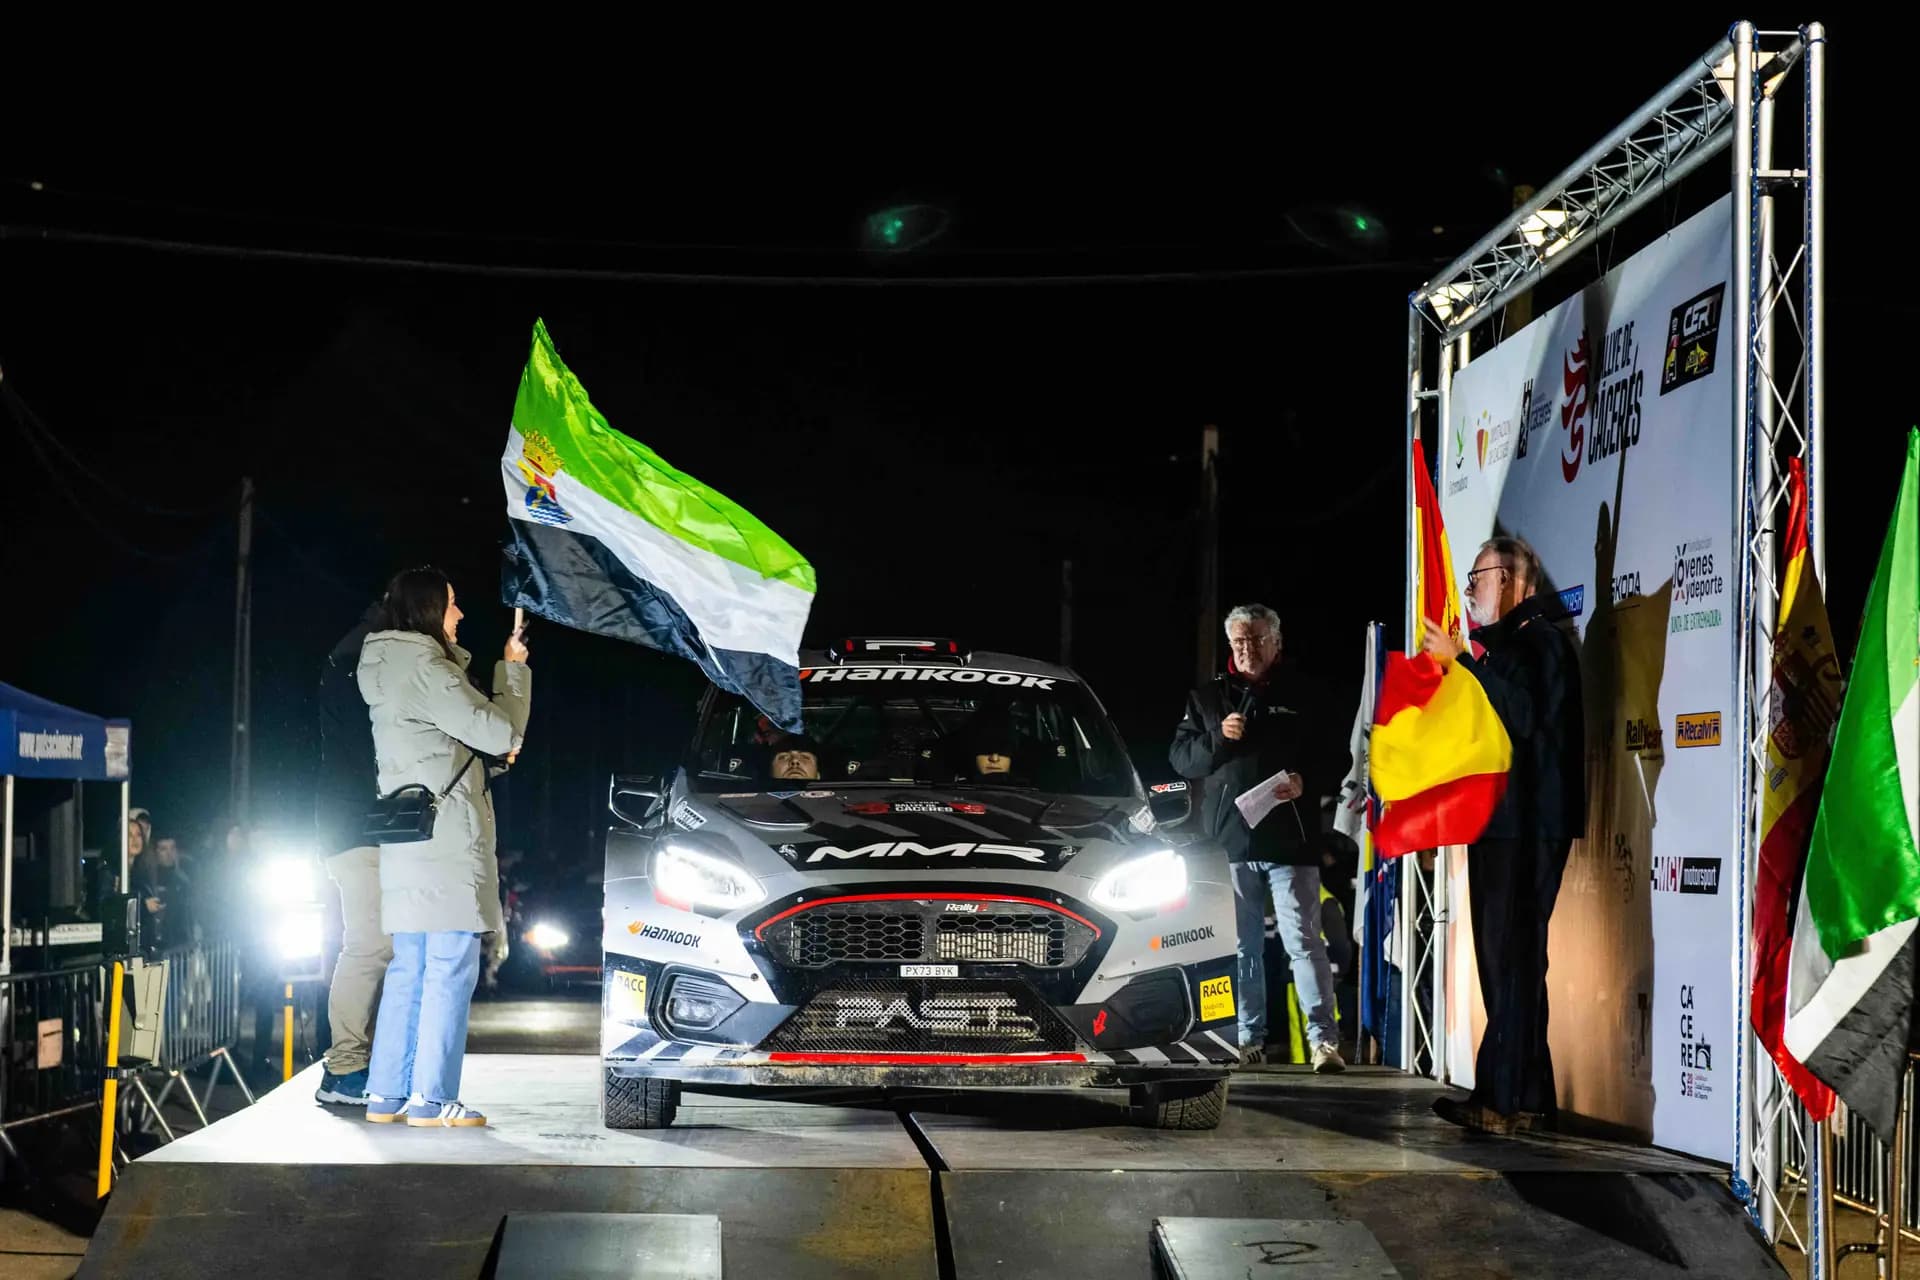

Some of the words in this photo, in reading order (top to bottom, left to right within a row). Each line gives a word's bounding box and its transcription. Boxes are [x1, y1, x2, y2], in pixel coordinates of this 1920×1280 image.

[905, 966, 931, 977] PX73
[935, 966, 954, 977] BYK
[1203, 980, 1230, 998] RACC
